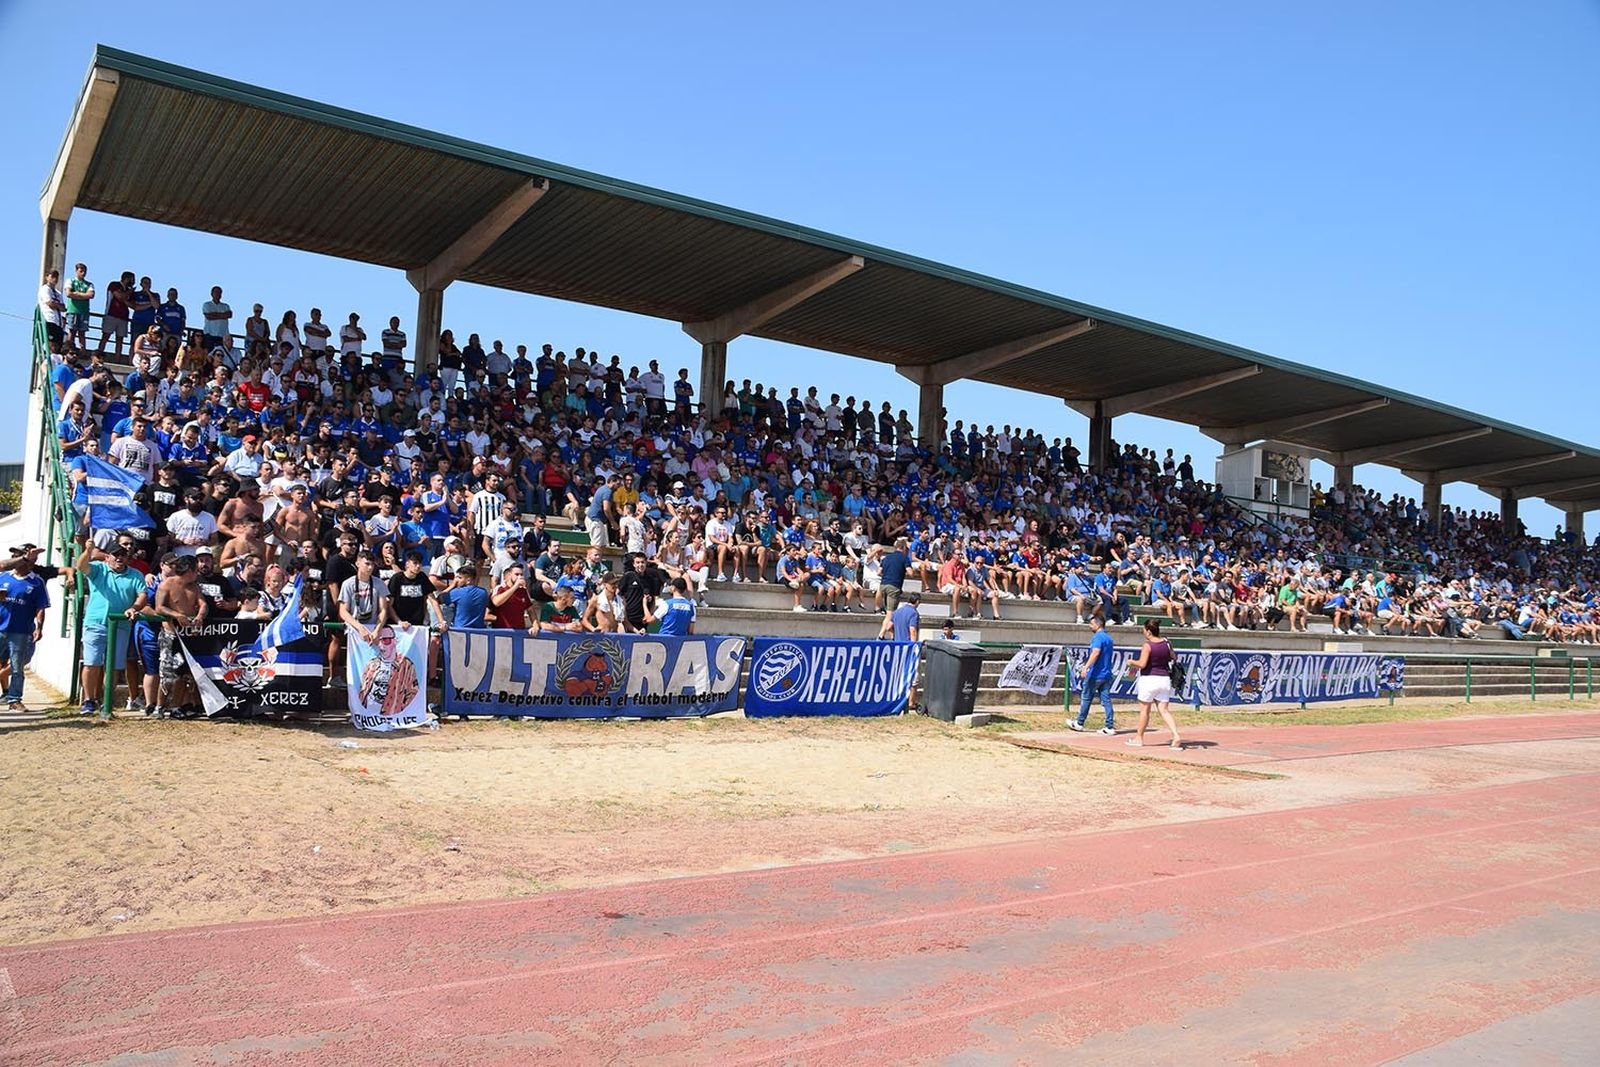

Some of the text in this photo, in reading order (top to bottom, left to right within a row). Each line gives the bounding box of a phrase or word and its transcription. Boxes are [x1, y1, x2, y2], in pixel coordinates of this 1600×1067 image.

[260, 691, 309, 706] XEREZ
[453, 687, 493, 703] Xerez
[498, 691, 563, 706] Deportivo
[569, 695, 611, 706] contra
[617, 693, 628, 706] el
[633, 692, 674, 706] futbol
